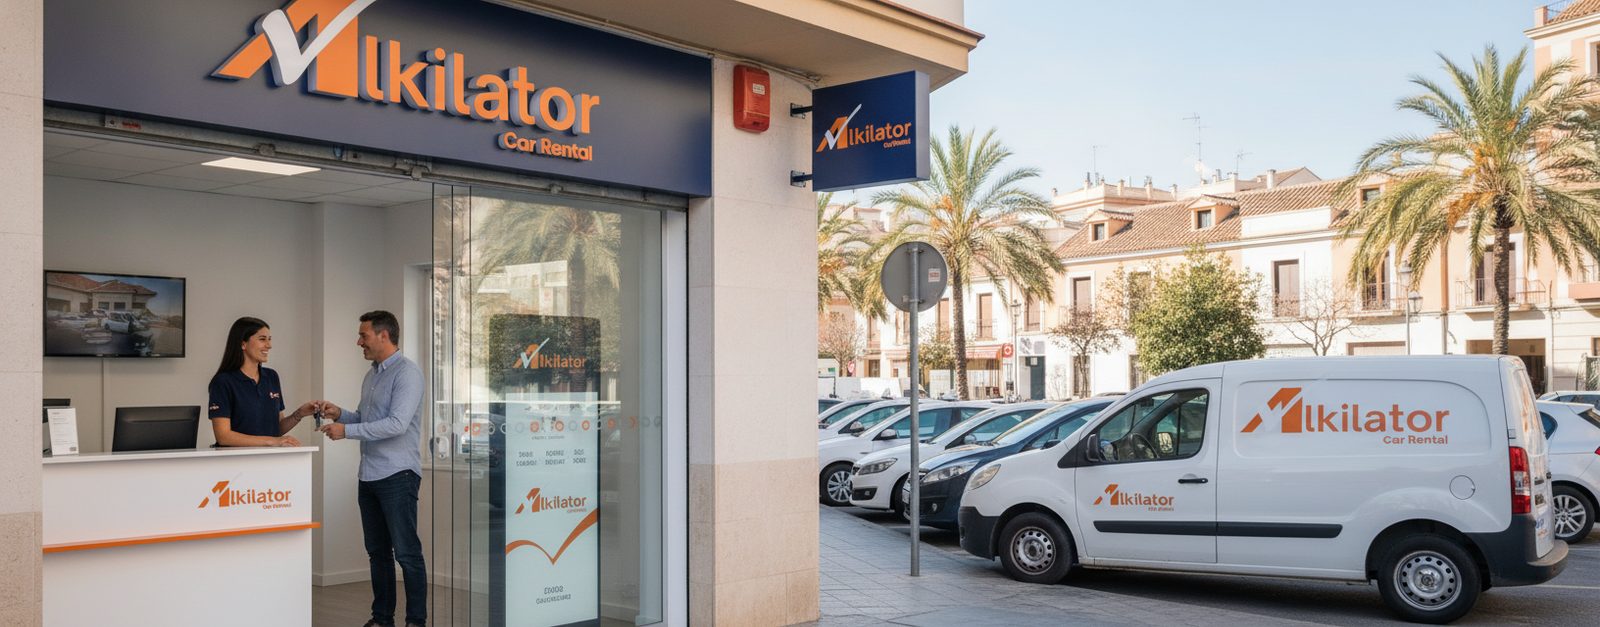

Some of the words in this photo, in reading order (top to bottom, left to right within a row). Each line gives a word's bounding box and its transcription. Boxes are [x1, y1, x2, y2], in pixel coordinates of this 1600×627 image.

[502, 131, 537, 154] Car
[540, 137, 593, 161] Rental
[1383, 435, 1406, 445] Car
[1408, 434, 1448, 445] Rental
